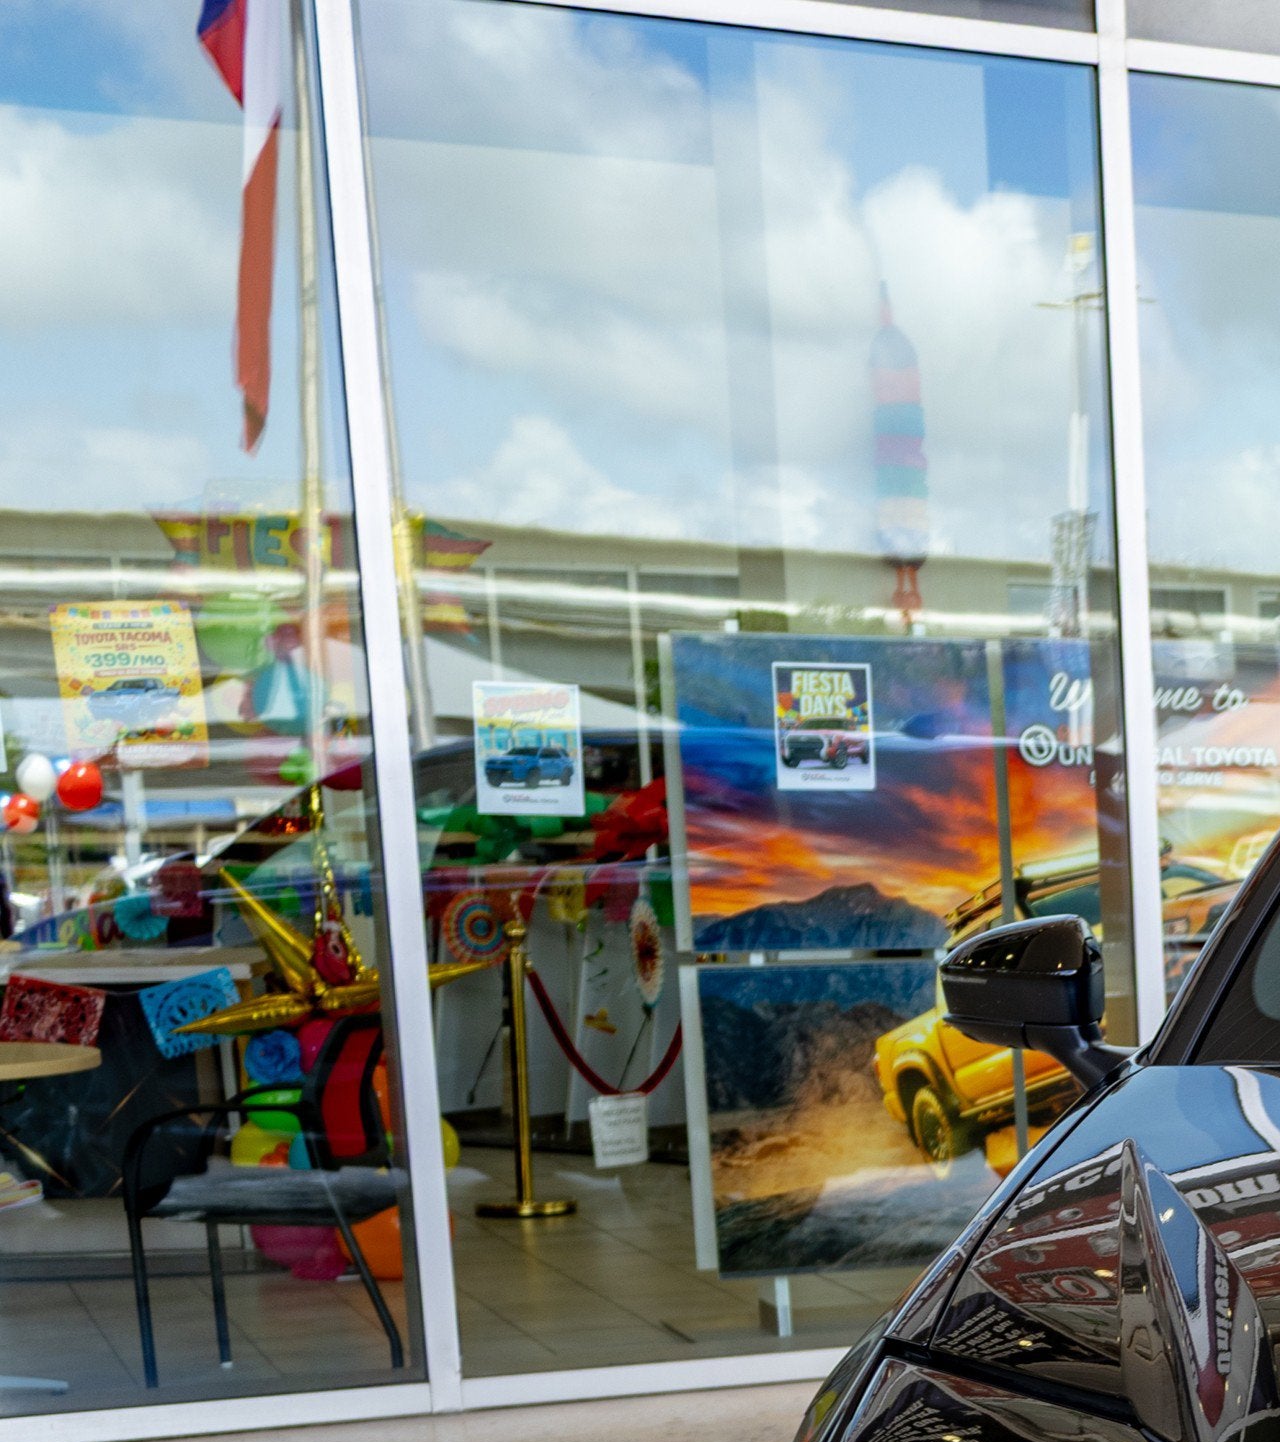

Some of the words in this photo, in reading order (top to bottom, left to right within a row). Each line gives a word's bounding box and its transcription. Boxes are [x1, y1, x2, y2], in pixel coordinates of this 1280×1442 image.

[74, 632, 117, 646] TOYOTA
[120, 630, 172, 644] TACOMA
[791, 671, 855, 696] FIESTA
[800, 694, 847, 717] DAYS
[1213, 683, 1249, 709] to
[1195, 746, 1279, 767] TOYOTA
